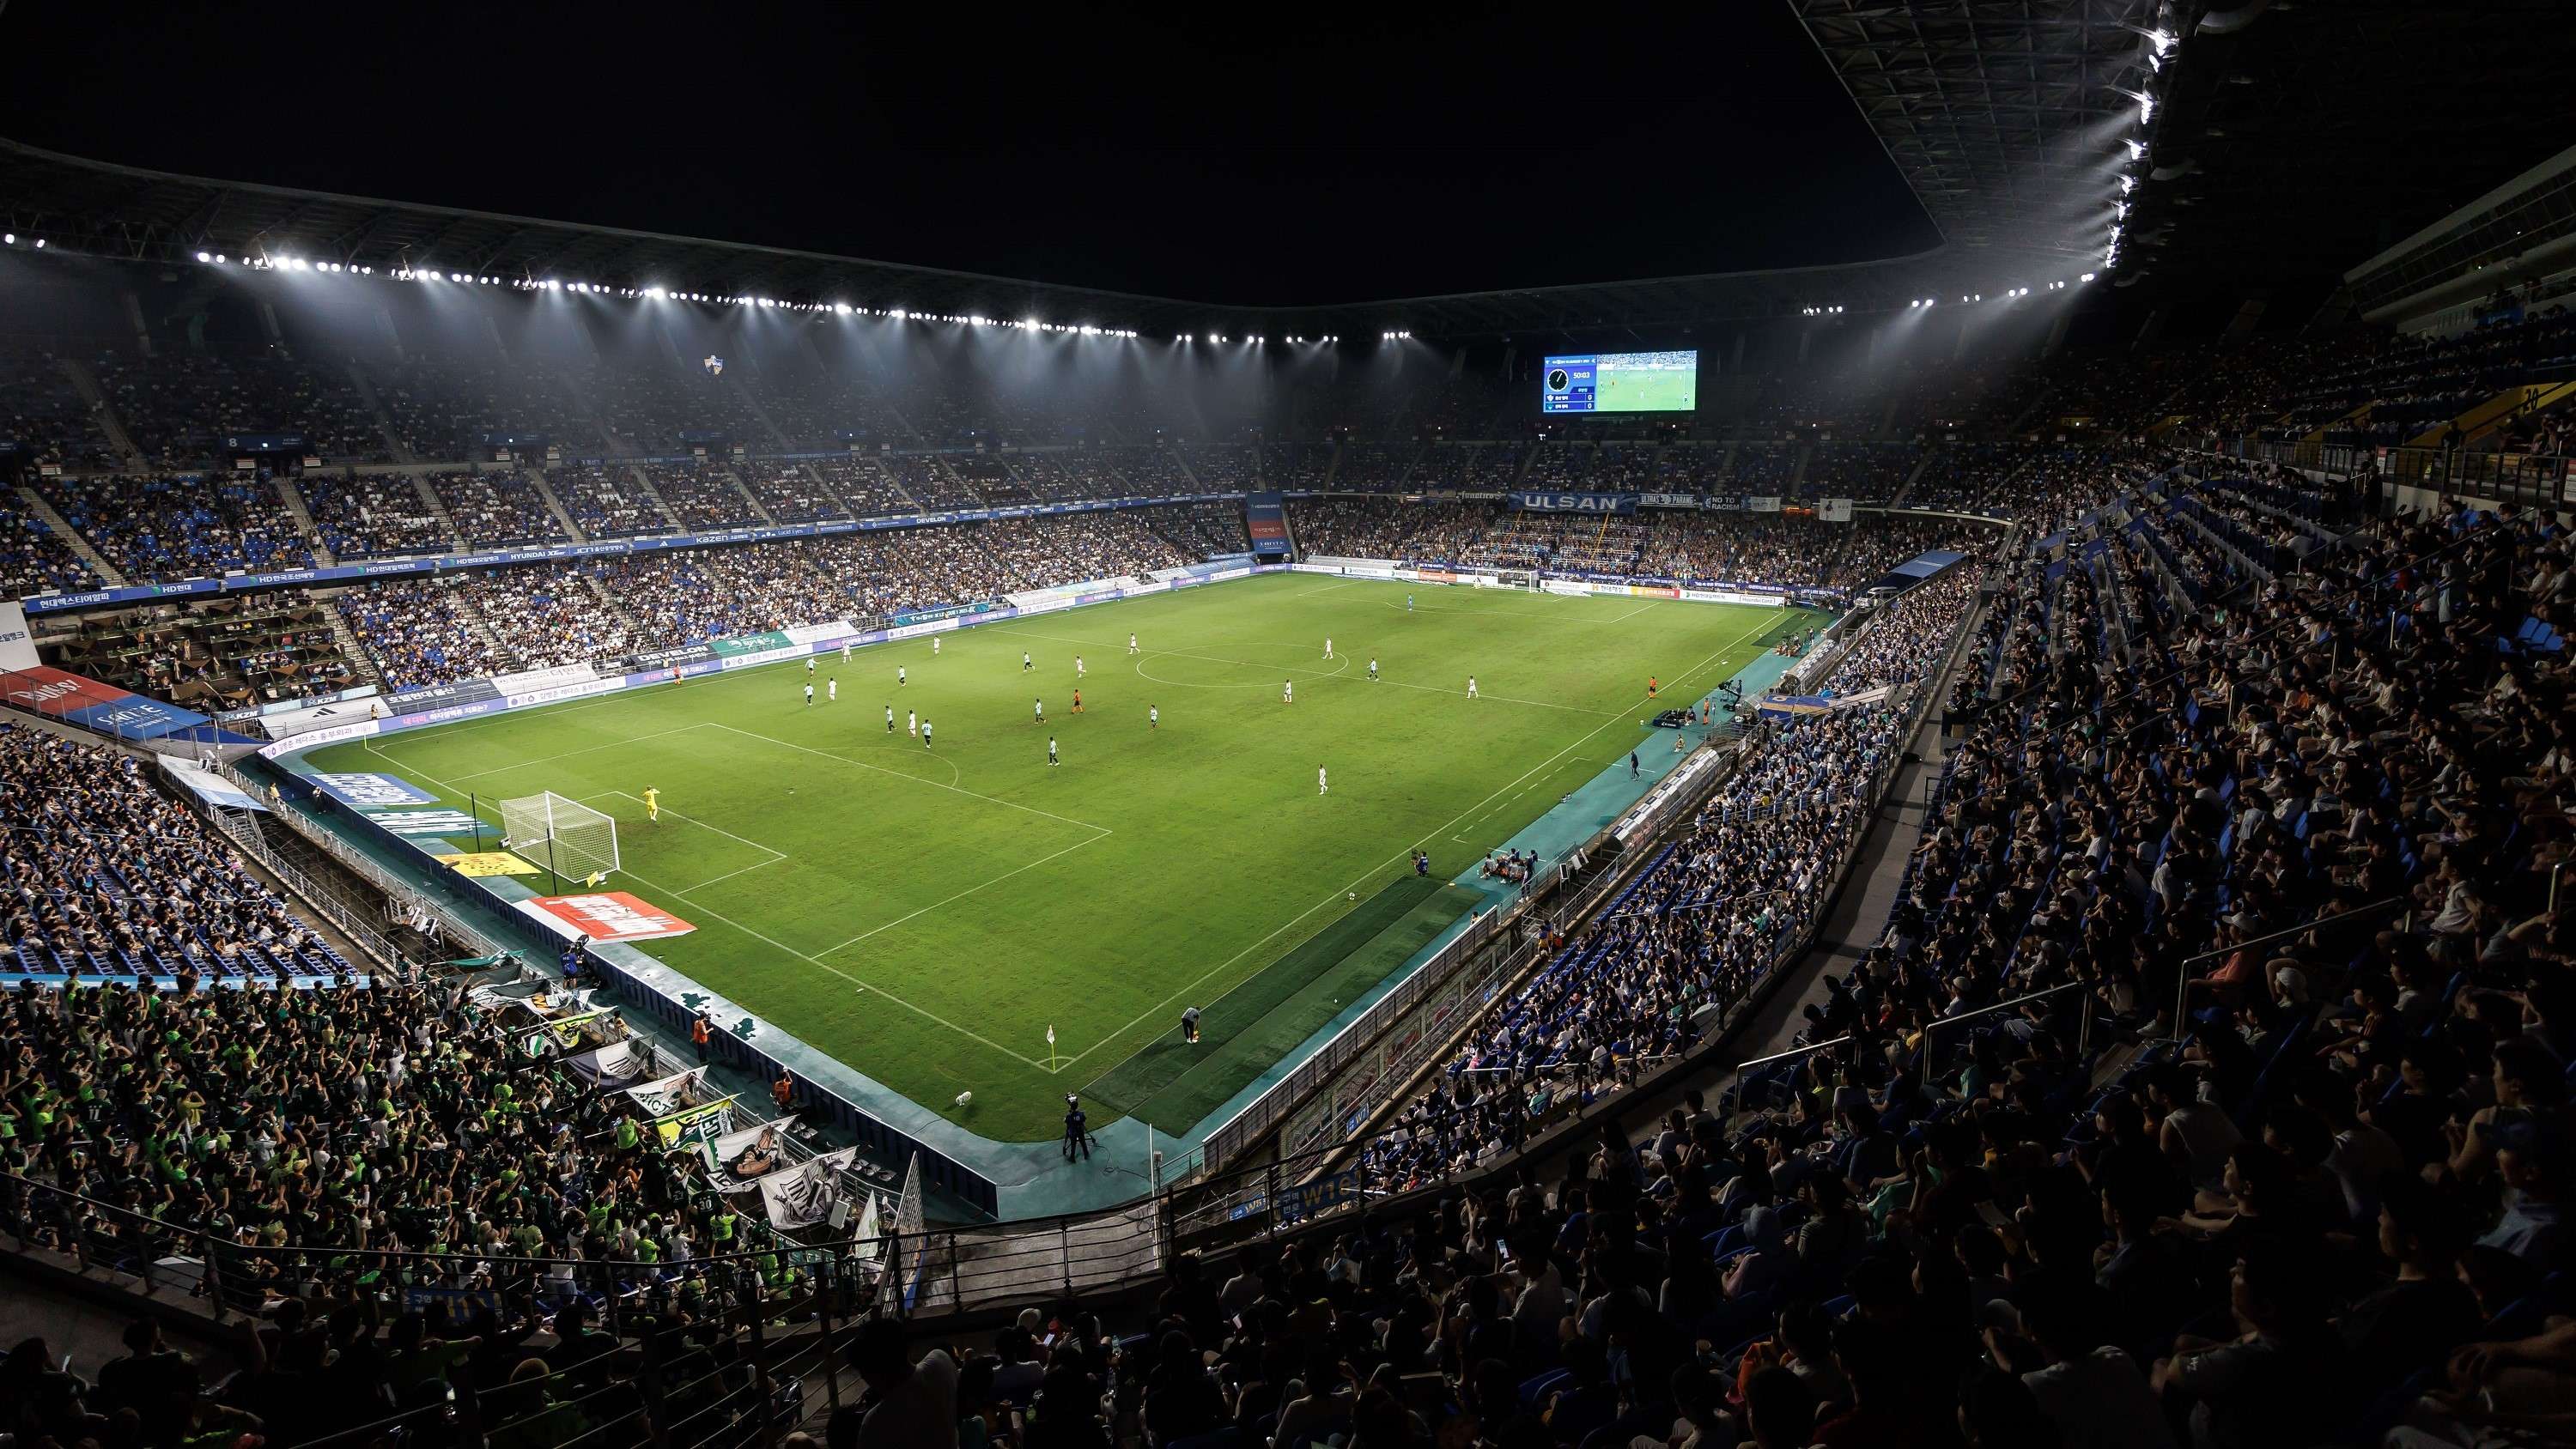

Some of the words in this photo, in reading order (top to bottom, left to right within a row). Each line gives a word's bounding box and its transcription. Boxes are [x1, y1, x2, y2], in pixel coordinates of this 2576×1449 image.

[228, 438, 238, 447] 8
[483, 433, 489, 442] 7
[1525, 494, 1617, 510] ULSAN
[1641, 494, 1660, 504] ULTRAS
[1672, 495, 1694, 505] PARANG
[511, 552, 545, 561] HYUNDAI
[259, 572, 314, 584] HD한국조선해양
[162, 584, 191, 593] HD현대
[39, 592, 110, 609] 현대엑스티어알파
[638, 645, 708, 661] DEVELON
[317, 695, 337, 705] KZM
[236, 710, 258, 720] KZM
[699, 1198, 712, 1210] 30
